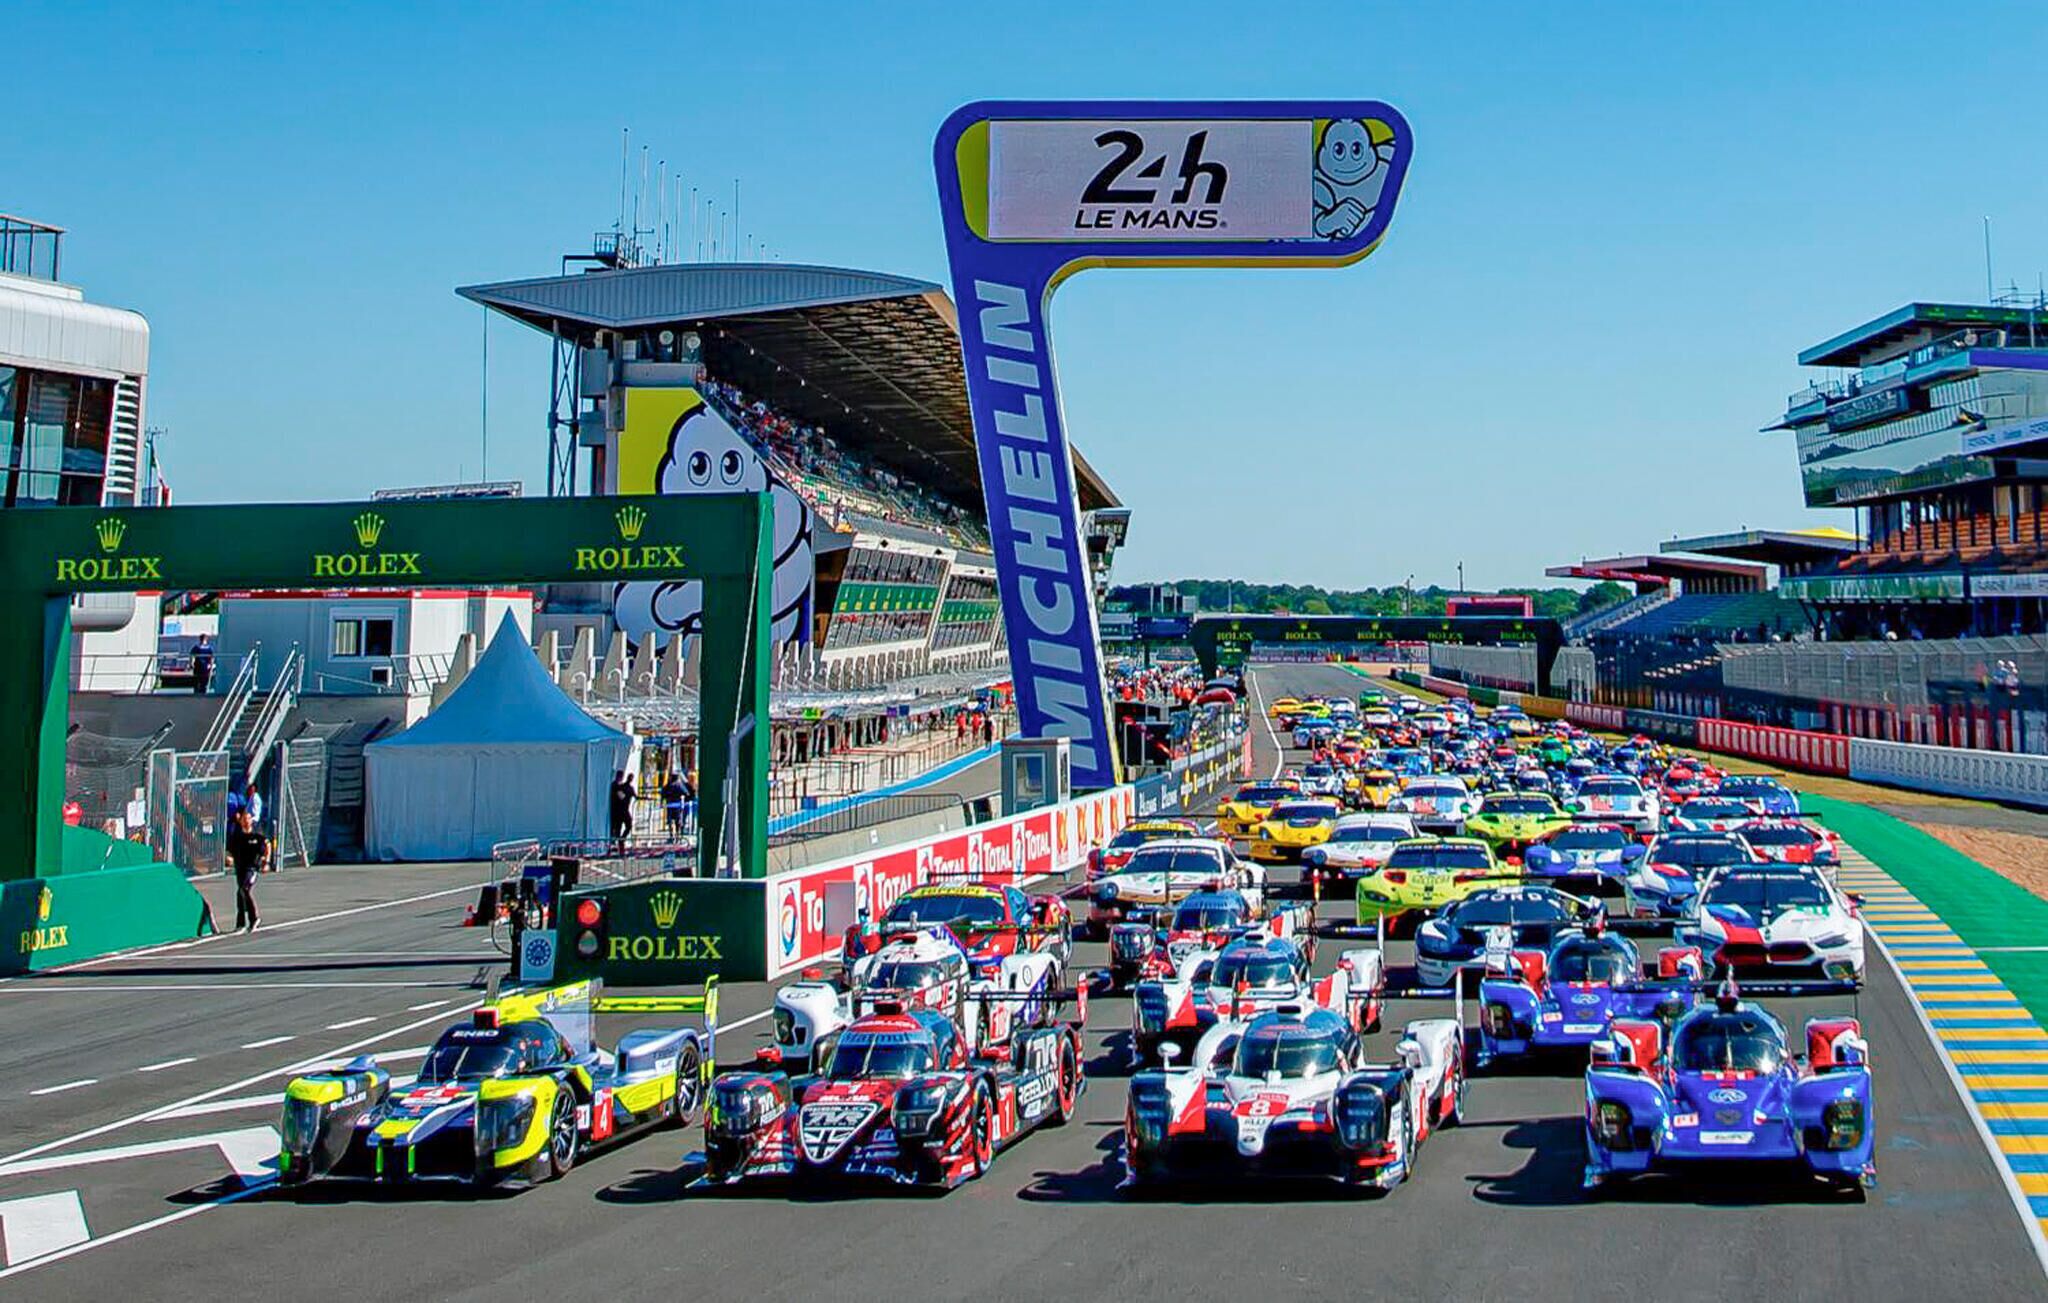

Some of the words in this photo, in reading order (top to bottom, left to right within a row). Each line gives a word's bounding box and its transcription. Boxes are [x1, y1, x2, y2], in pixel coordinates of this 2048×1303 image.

[1081, 130, 1228, 203] 24h
[1075, 210, 1116, 228] LE
[1122, 210, 1218, 228] MANS
[975, 279, 1099, 771] MICHELIN
[57, 557, 162, 580] ROLEX
[313, 553, 422, 576] ROLEX
[576, 546, 686, 570] ROLEX
[983, 842, 1012, 873] TOTAL
[1025, 830, 1051, 862] TOTAL
[1475, 892, 1543, 901] FORD
[20, 925, 69, 953] ROLEX
[607, 936, 722, 960] ROLEX
[600, 1104, 609, 1132] 4
[1249, 1100, 1271, 1115] 8
